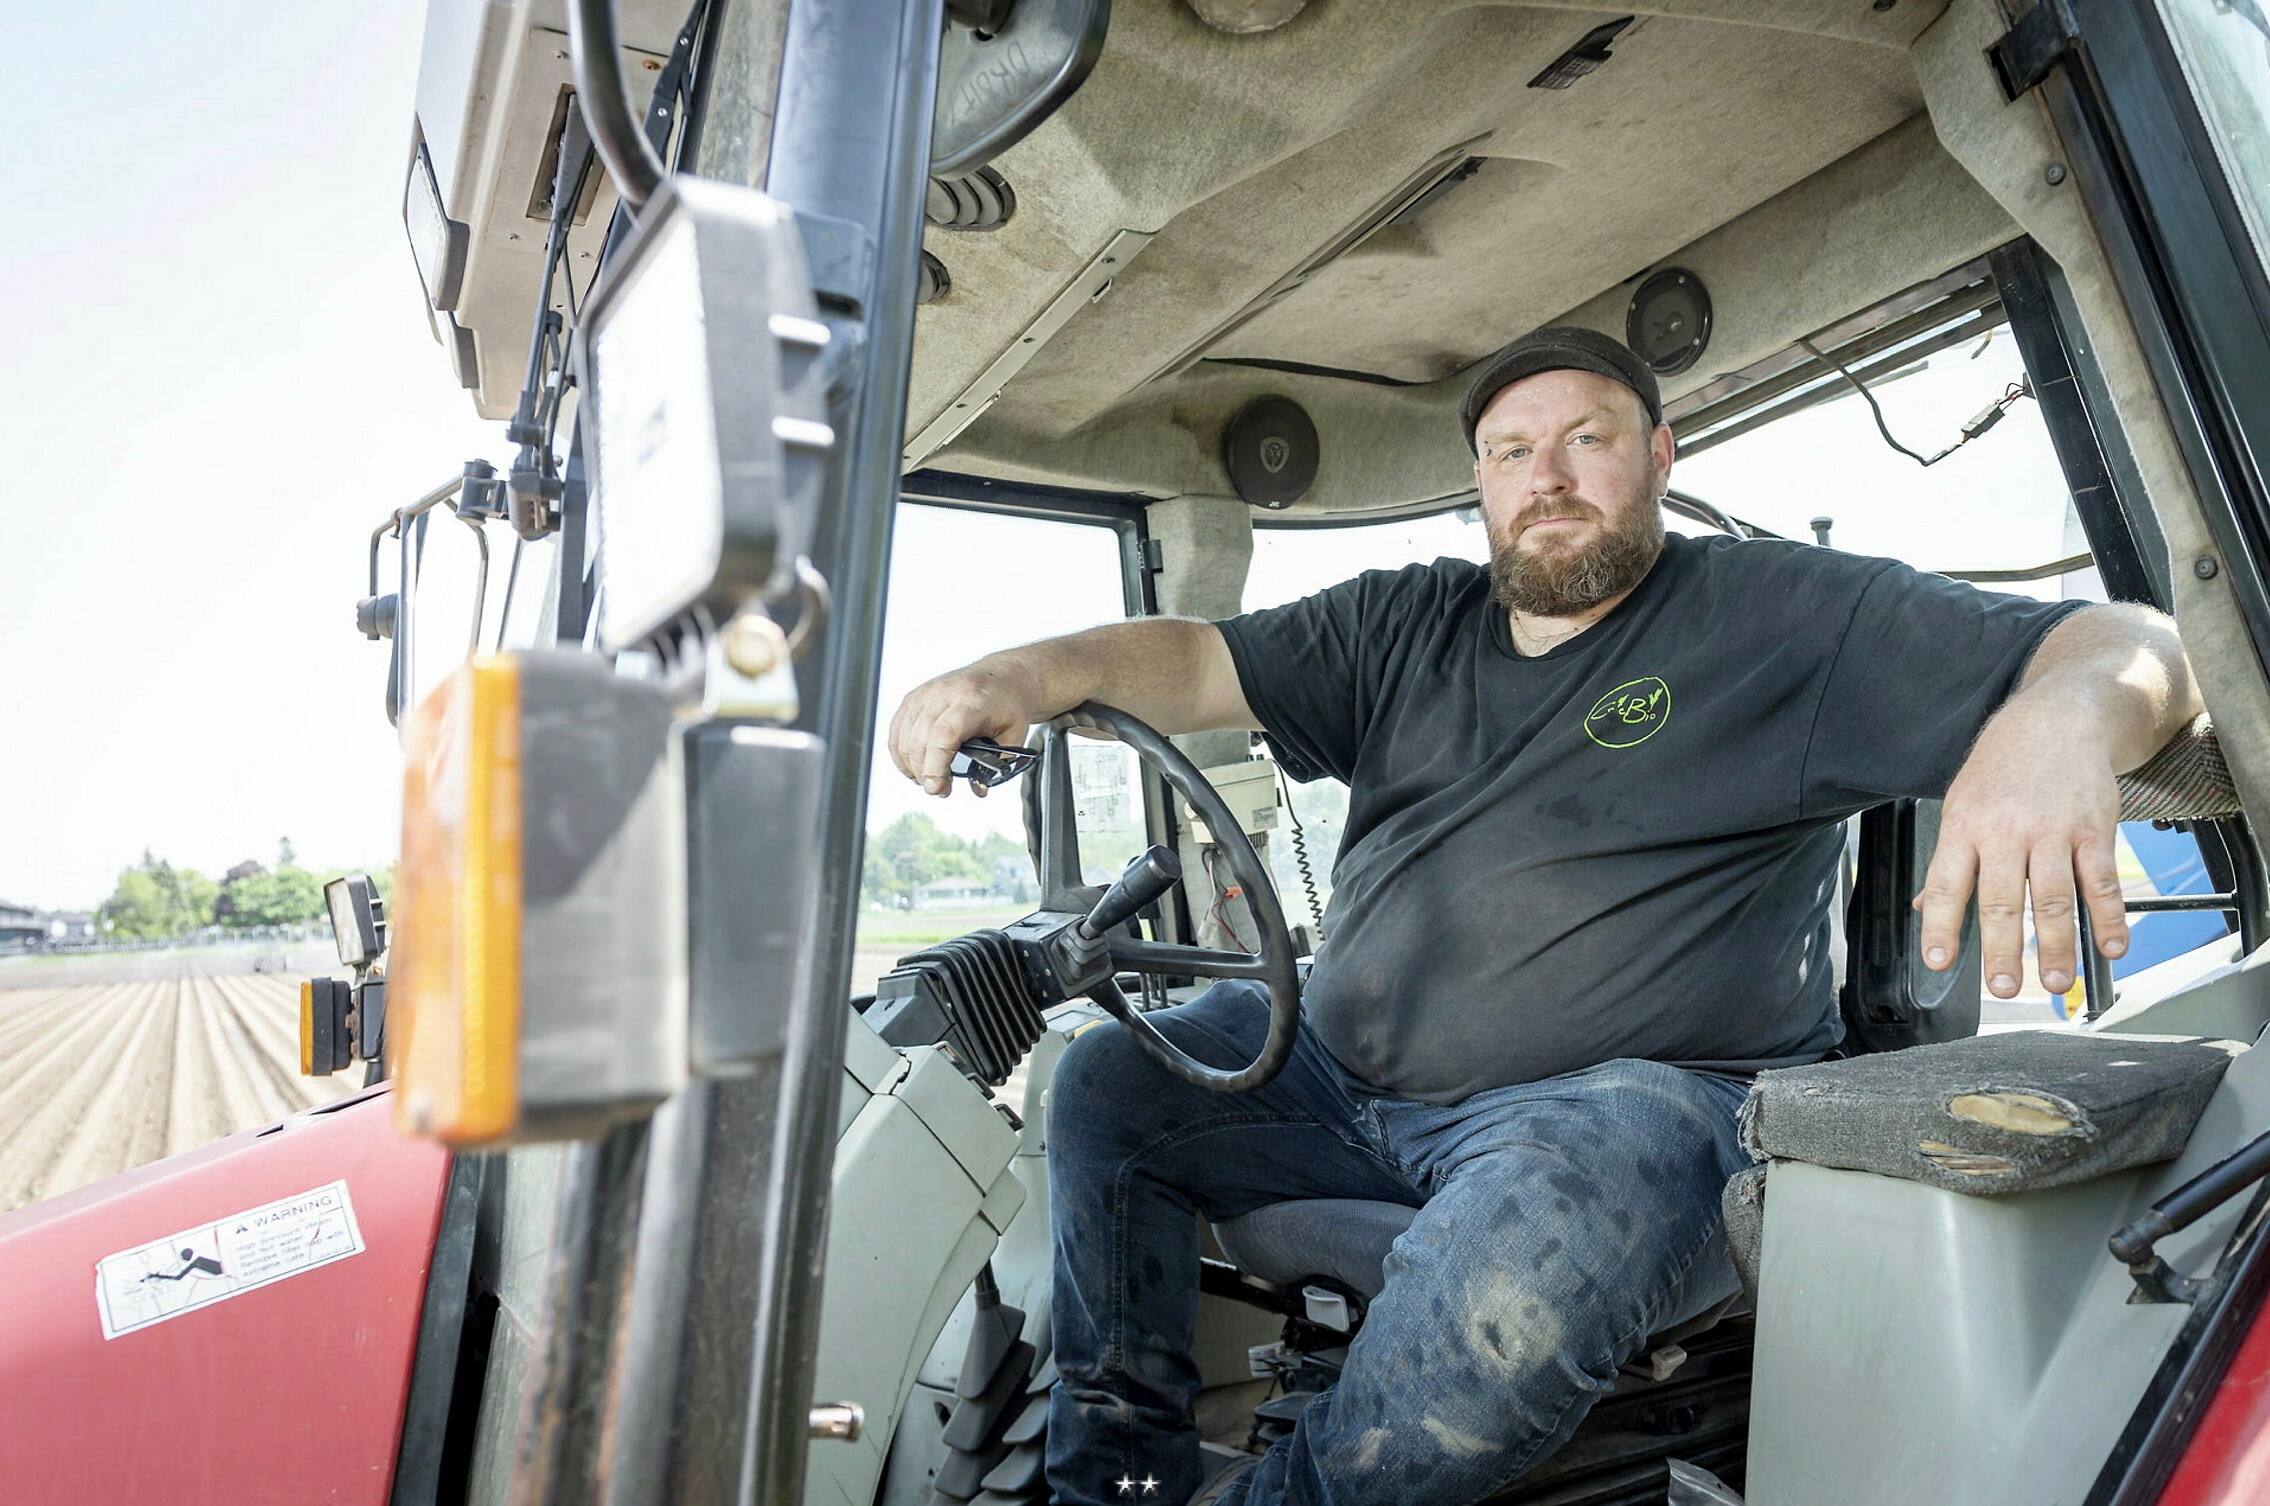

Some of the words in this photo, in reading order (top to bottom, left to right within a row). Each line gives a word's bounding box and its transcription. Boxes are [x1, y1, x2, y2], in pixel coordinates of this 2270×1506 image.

[255, 1195, 332, 1226] WARNING
[260, 1228, 301, 1244] pressure
[279, 1236, 303, 1247] water
